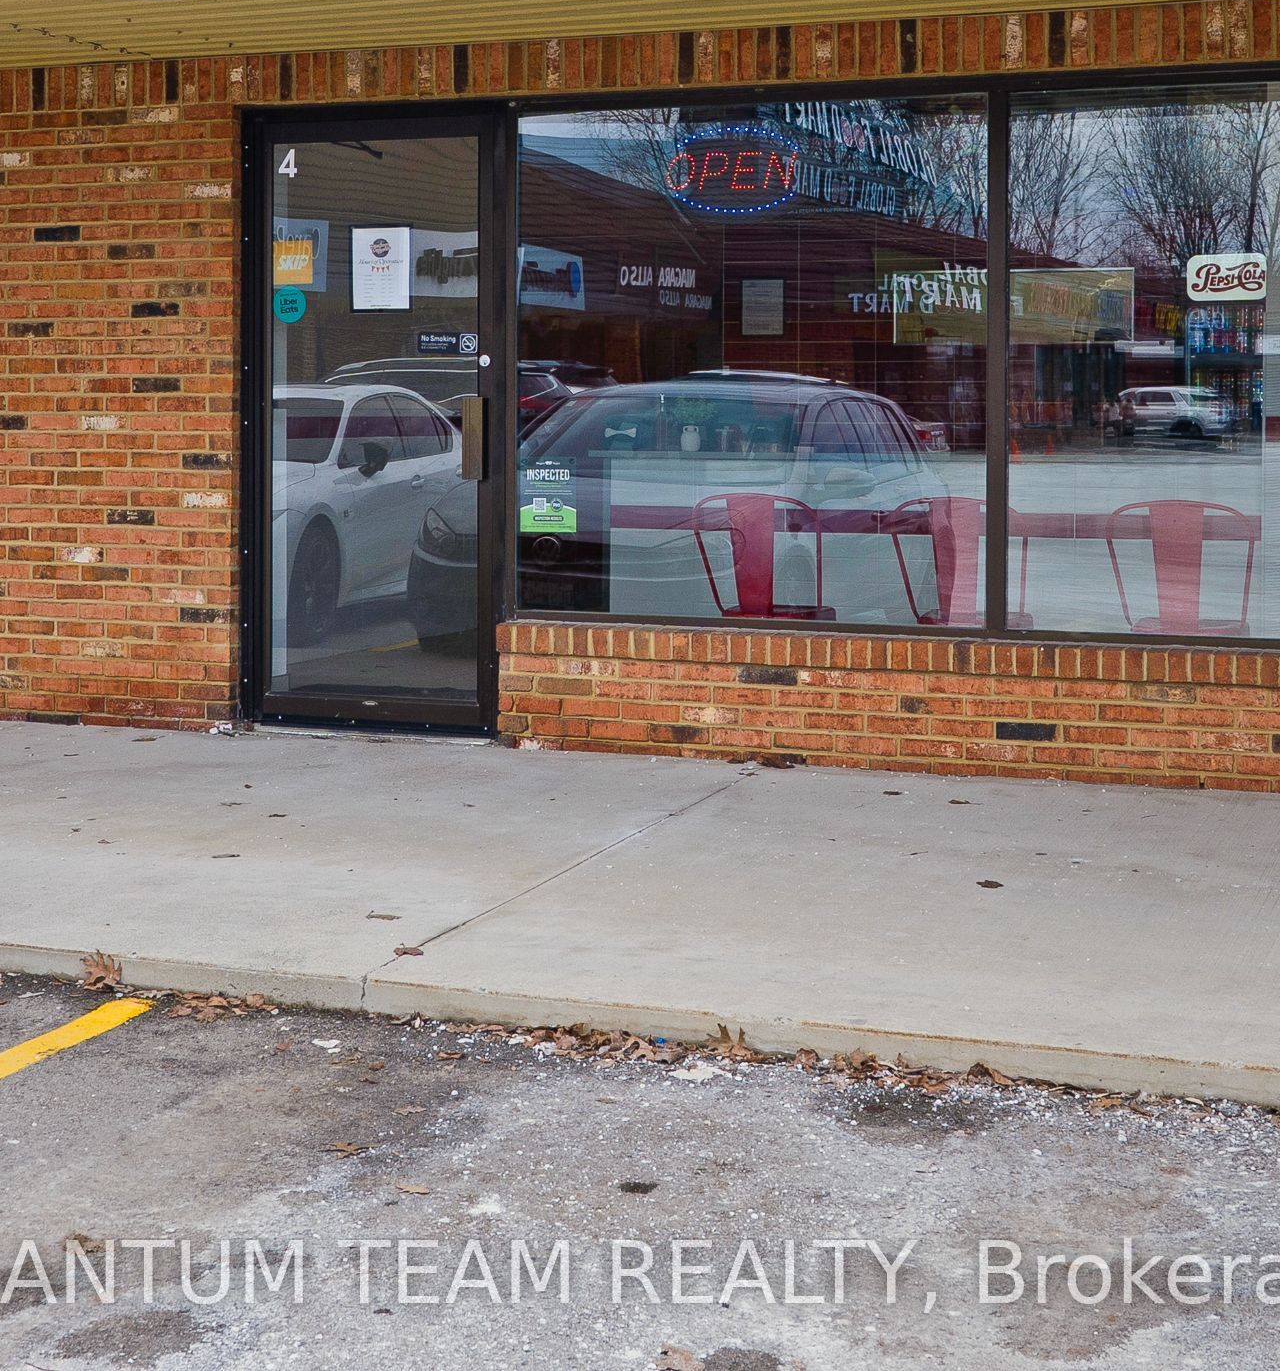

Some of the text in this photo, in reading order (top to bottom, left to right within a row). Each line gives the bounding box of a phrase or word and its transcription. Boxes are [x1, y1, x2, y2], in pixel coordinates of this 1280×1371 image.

[278, 148, 298, 178] 4
[666, 150, 798, 193] OPEN
[280, 298, 298, 306] Uber
[280, 306, 299, 314] Eats
[420, 334, 457, 344] No Smoking
[526, 468, 570, 481] INSPECTED
